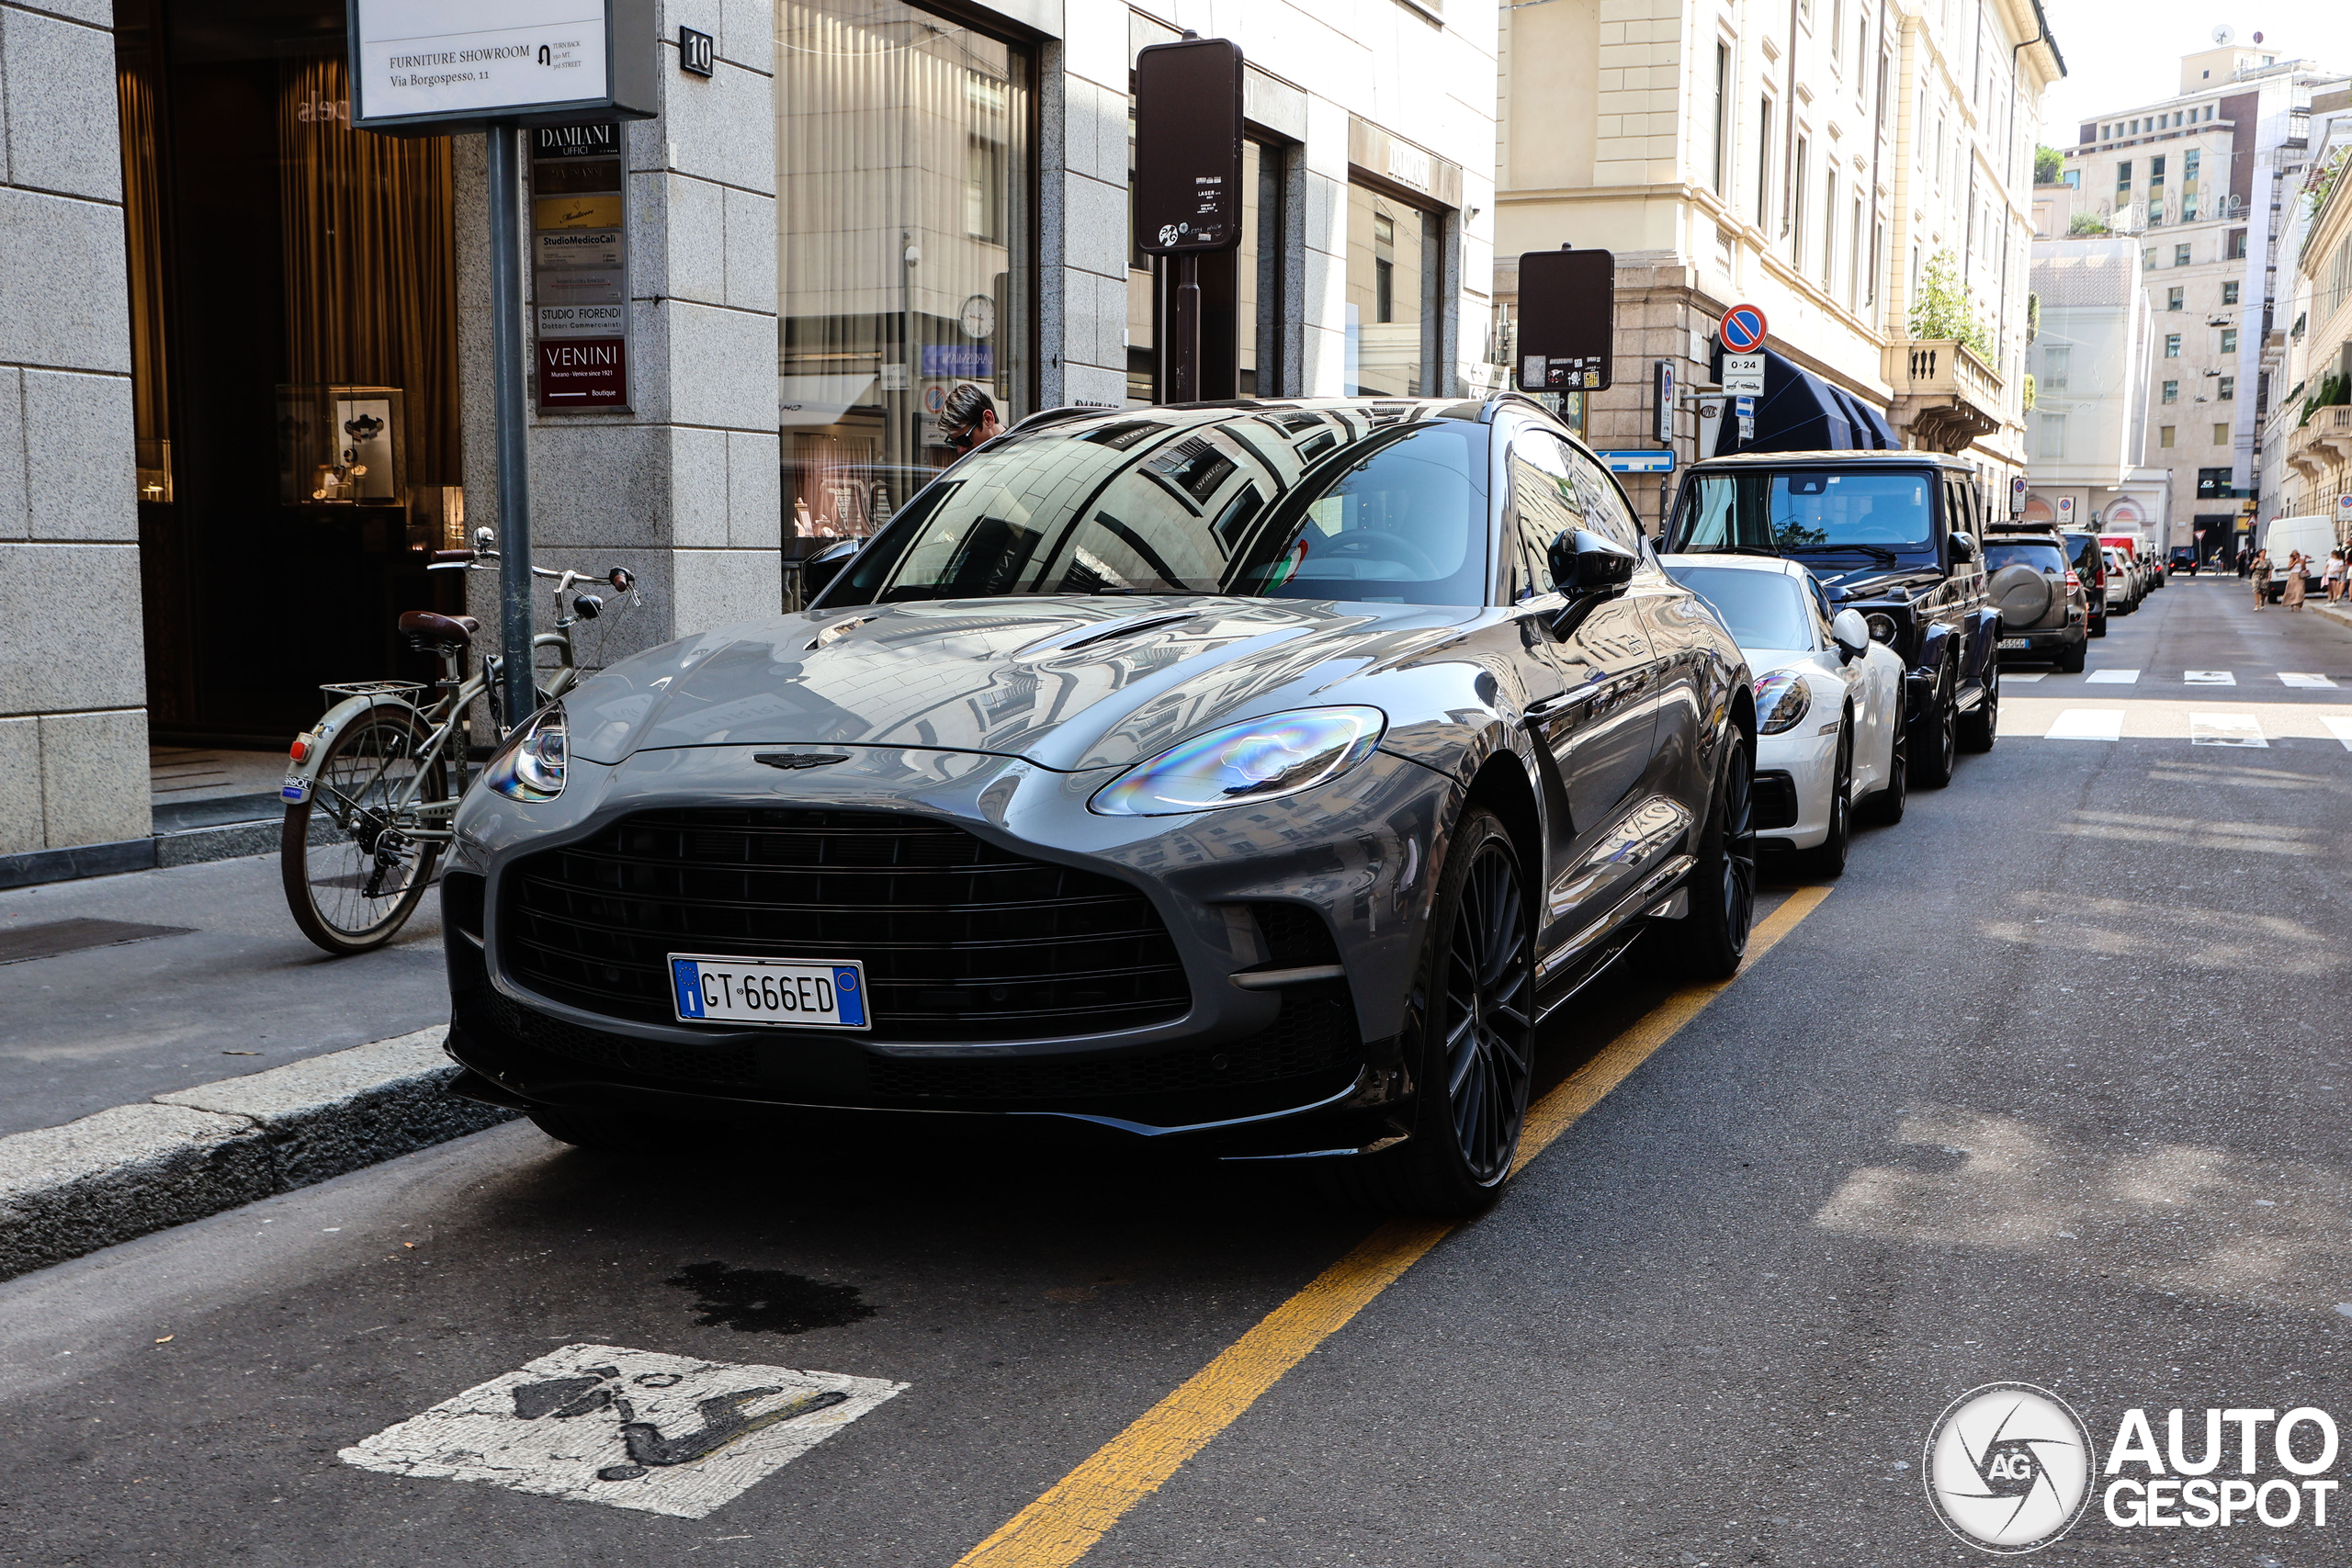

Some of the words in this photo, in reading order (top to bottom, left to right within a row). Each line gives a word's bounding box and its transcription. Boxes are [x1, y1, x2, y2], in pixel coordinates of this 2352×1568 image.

[390, 52, 456, 69] FURNITURE
[459, 45, 530, 63] SHOWROOM
[689, 35, 711, 69] 10
[390, 74, 407, 87] Via
[410, 71, 476, 87] Borgospesso,
[479, 71, 490, 80] 11
[541, 125, 610, 147] DAMIANI
[563, 147, 588, 155] UFFICI
[542, 310, 574, 320] STUDIO
[579, 308, 621, 318] FIORENDI
[547, 346, 616, 366] VENINI
